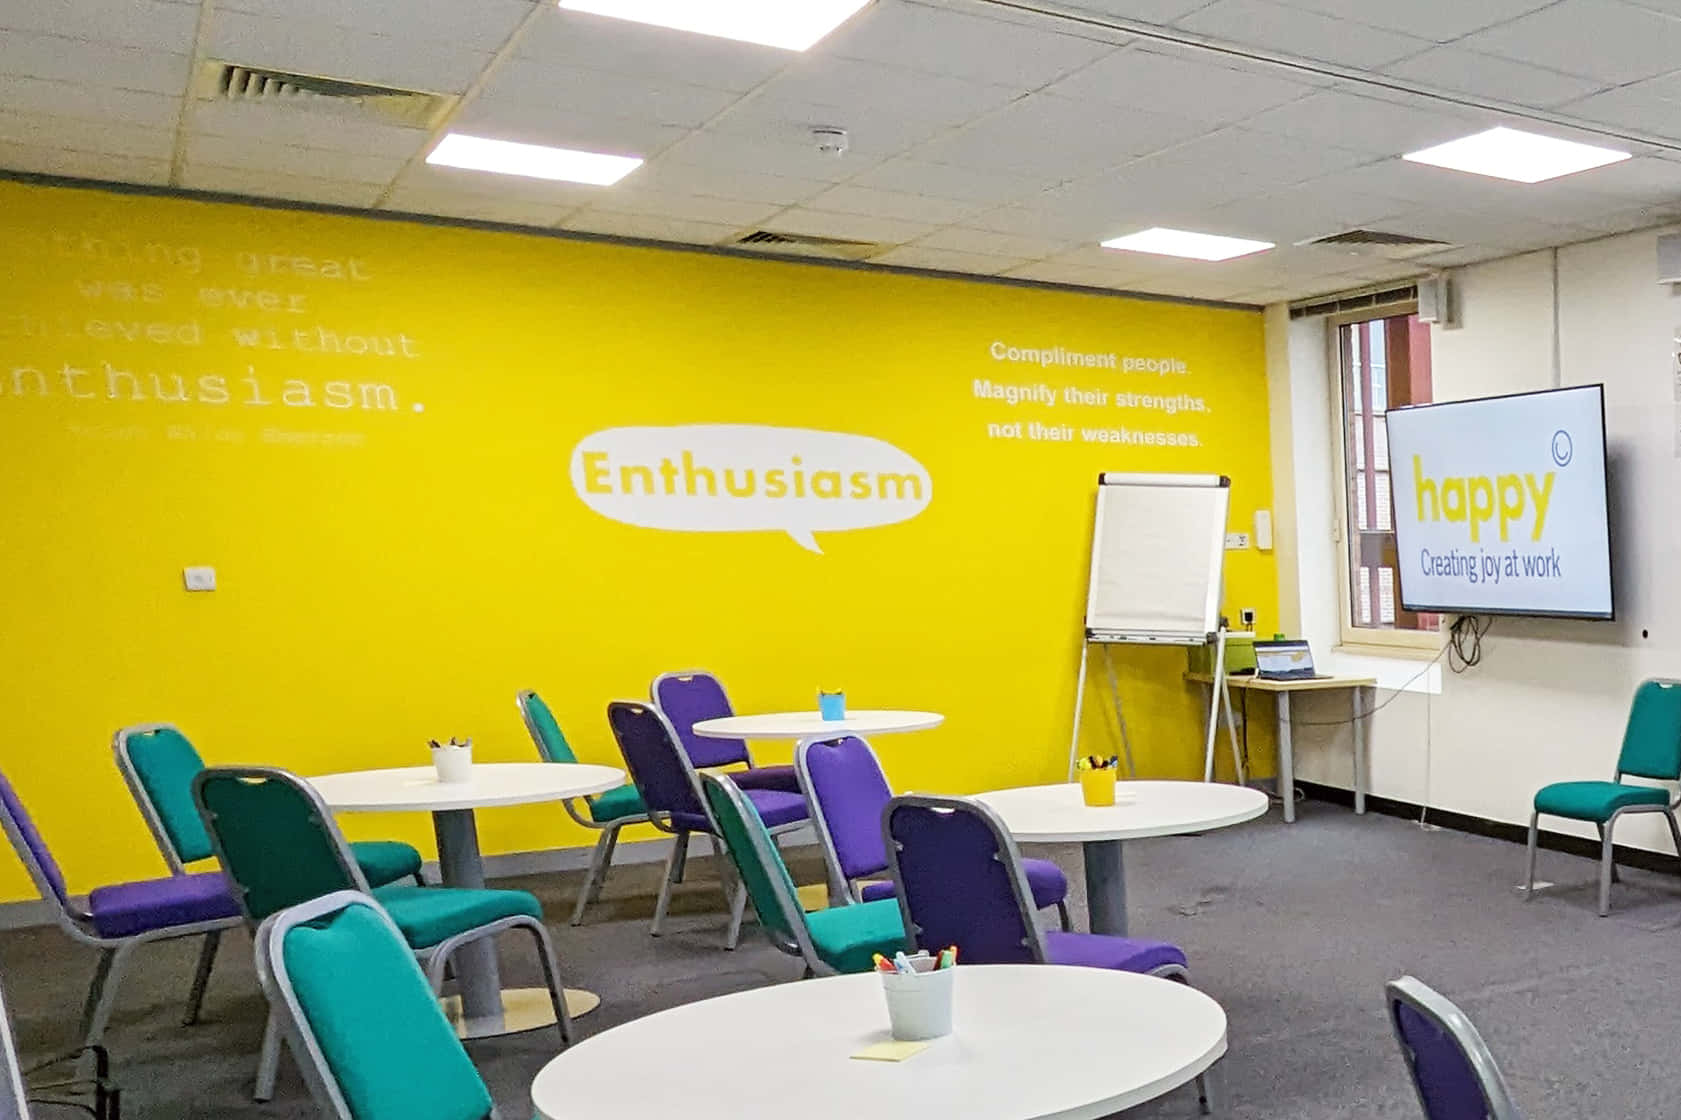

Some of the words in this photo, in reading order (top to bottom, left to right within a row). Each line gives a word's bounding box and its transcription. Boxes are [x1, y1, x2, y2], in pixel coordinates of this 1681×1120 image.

[236, 248, 372, 281] great
[77, 278, 168, 304] was
[197, 286, 309, 315] ever
[231, 326, 422, 360] without
[989, 341, 1117, 370] Compliment
[0, 360, 428, 414] nthusiasm.
[973, 378, 1056, 406] Magnify
[1063, 386, 1108, 406] their
[987, 421, 1022, 439] not
[1028, 422, 1074, 442] their
[1081, 426, 1203, 448] weaknesses.
[581, 450, 924, 502] Enthusiasm
[1412, 453, 1555, 543] happy
[1420, 548, 1479, 584] Creating
[1480, 548, 1501, 585] joy
[1504, 549, 1520, 578] at
[1522, 547, 1562, 579] work
